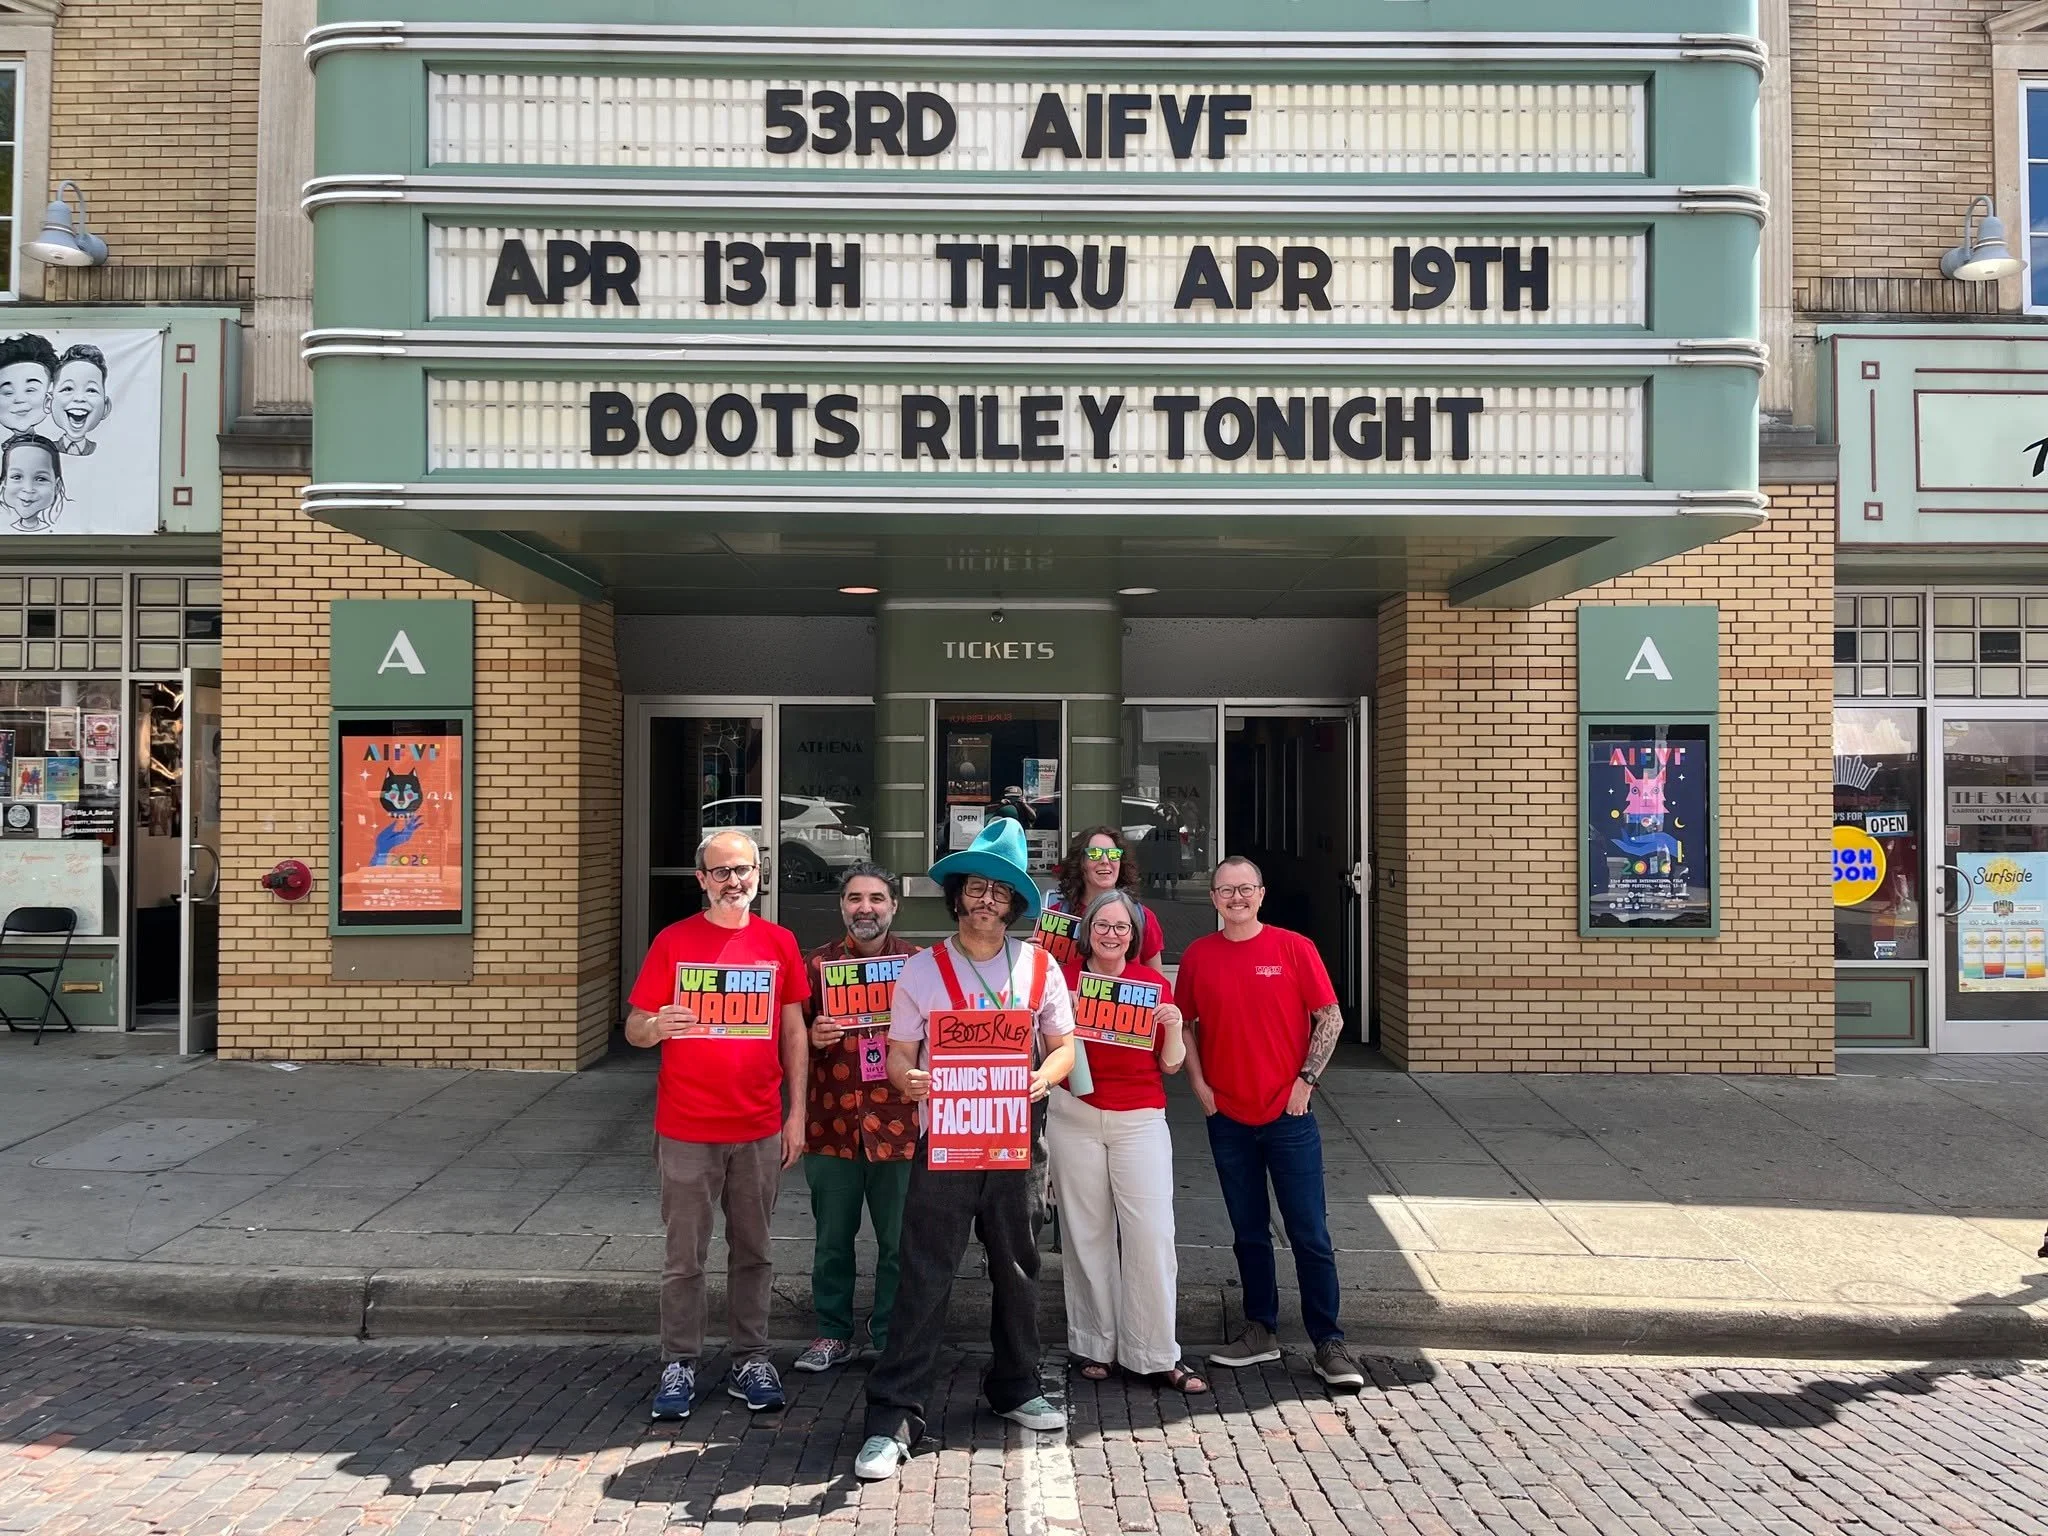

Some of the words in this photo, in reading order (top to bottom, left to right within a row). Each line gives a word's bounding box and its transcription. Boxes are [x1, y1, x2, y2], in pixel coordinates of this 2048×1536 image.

[765, 89, 957, 156] 53RD
[1021, 92, 1252, 160] AIFVF
[487, 238, 641, 306] APR
[704, 240, 861, 308] 13TH
[936, 243, 1127, 310] THRU
[1174, 245, 1333, 311] APR
[1393, 246, 1549, 312] 19TH
[589, 391, 860, 458] BOOTS
[901, 395, 1125, 460] RILEY
[1154, 396, 1484, 461] TONIGHT
[377, 630, 426, 674] A
[942, 641, 1055, 660] TICKETS
[1624, 636, 1673, 681] A
[363, 743, 442, 761] AIFVF
[797, 741, 864, 753] ATHENA
[1608, 747, 1686, 766] AIFVF
[1952, 791, 1989, 805] THE
[1847, 812, 1863, 821] FOR
[1870, 817, 1906, 833] OPEN
[797, 828, 864, 841] ATHENA
[391, 855, 429, 866] 2026
[1973, 867, 2033, 885] Surfside
[1041, 913, 1071, 936] WE
[681, 969, 718, 992] WE
[725, 970, 771, 993] ARE
[825, 964, 859, 986] WE
[1081, 977, 1114, 1001] WE
[1118, 984, 1158, 1009] ARE
[1076, 997, 1155, 1036] UAOU
[934, 1016, 992, 1048] BOOTS
[991, 1013, 1030, 1047] RILEY
[932, 1067, 988, 1092] STANDS
[990, 1066, 1028, 1090] WITH
[931, 1096, 1028, 1135] FACULTY!
